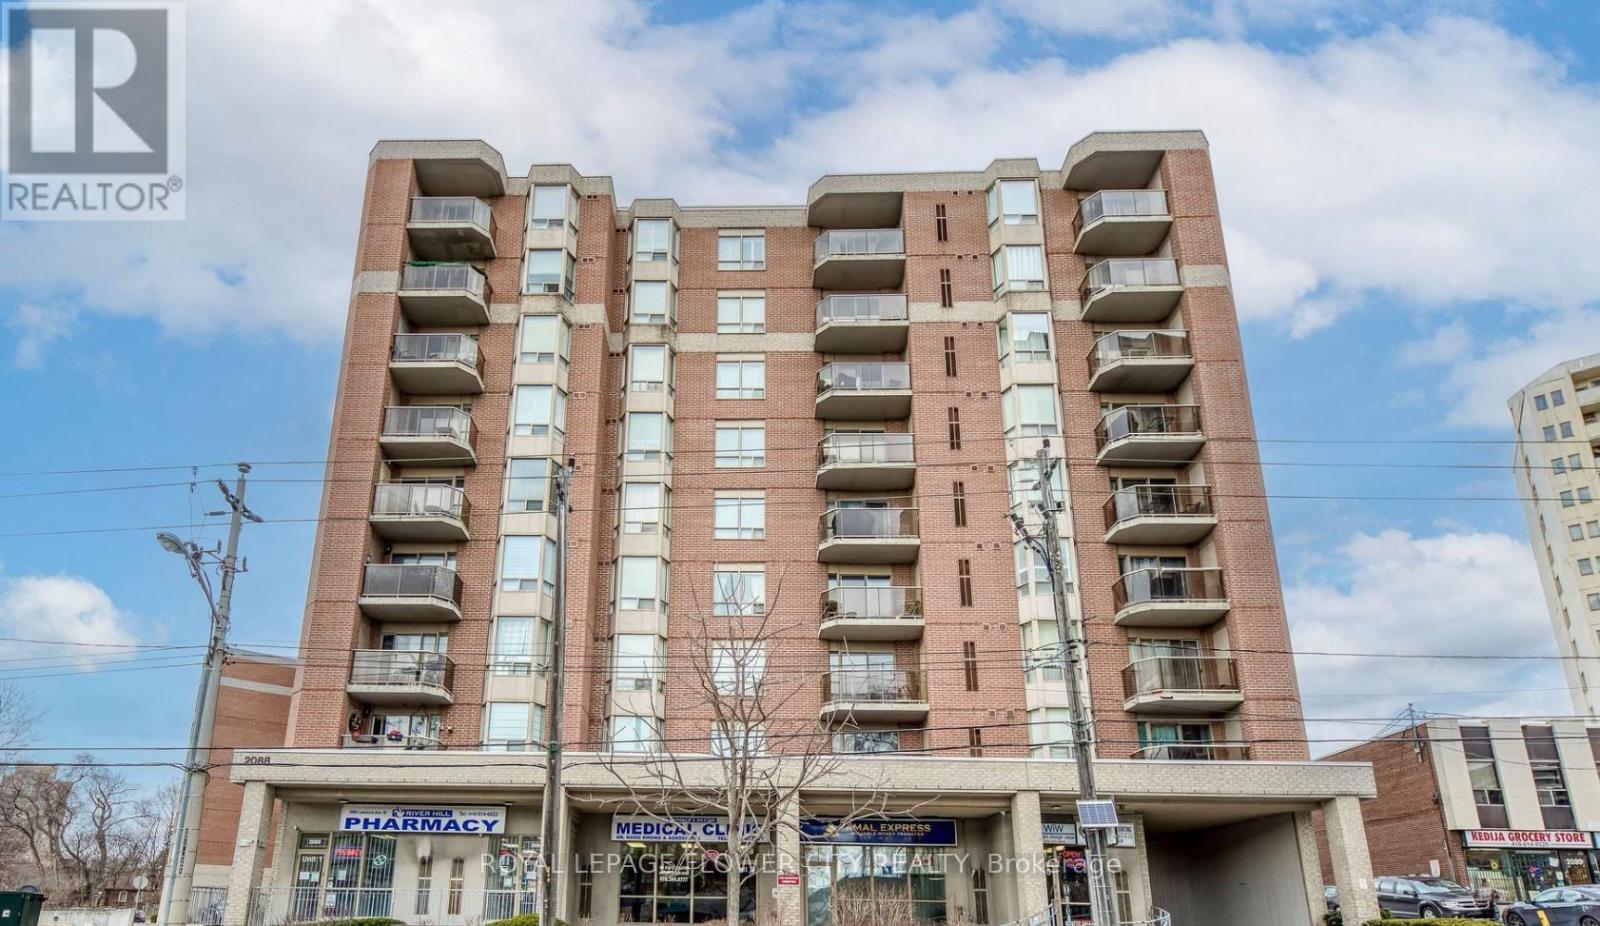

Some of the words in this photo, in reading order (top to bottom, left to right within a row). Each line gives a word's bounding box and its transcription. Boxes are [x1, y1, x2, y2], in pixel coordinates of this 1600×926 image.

[244, 756, 270, 765] 2088
[345, 817, 499, 832] PHARMACY
[616, 822, 697, 835] MEDICAL
[880, 824, 931, 832] EXPRESS
[1471, 831, 1505, 841] KEDIJA
[1508, 832, 1551, 842] GROCERY
[1555, 833, 1586, 842] STORE
